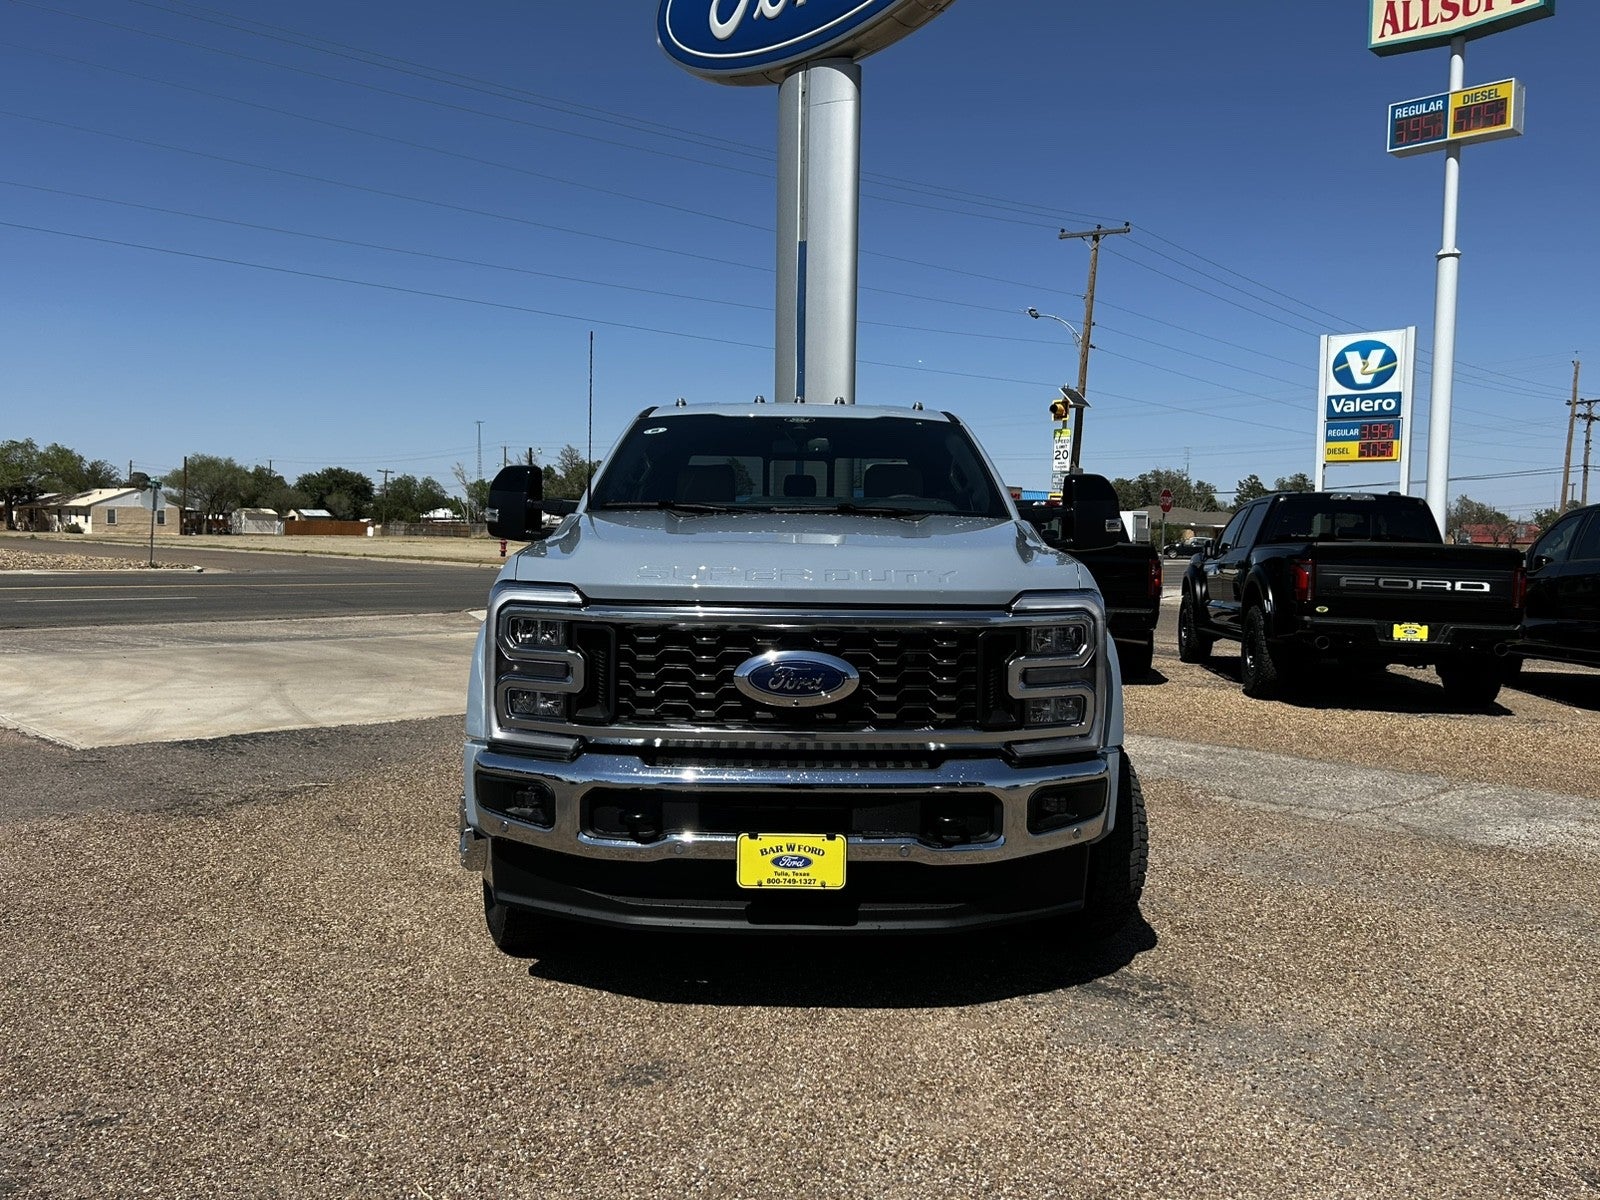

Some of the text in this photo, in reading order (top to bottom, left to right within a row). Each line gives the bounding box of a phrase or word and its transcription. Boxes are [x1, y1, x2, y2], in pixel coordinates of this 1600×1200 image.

[1378, 0, 1526, 38] ALLSU
[1463, 88, 1500, 105] DIESEL
[1395, 100, 1443, 119] REGULAR
[1331, 397, 1396, 413] Valero
[1328, 429, 1359, 437] REGULAR
[1054, 450, 1069, 460] 20
[637, 565, 958, 584] SUPER DUTY
[1339, 576, 1491, 592] FORD
[768, 666, 825, 690] Ford
[760, 843, 825, 856] BAR W FORD
[779, 856, 805, 866] Ford
